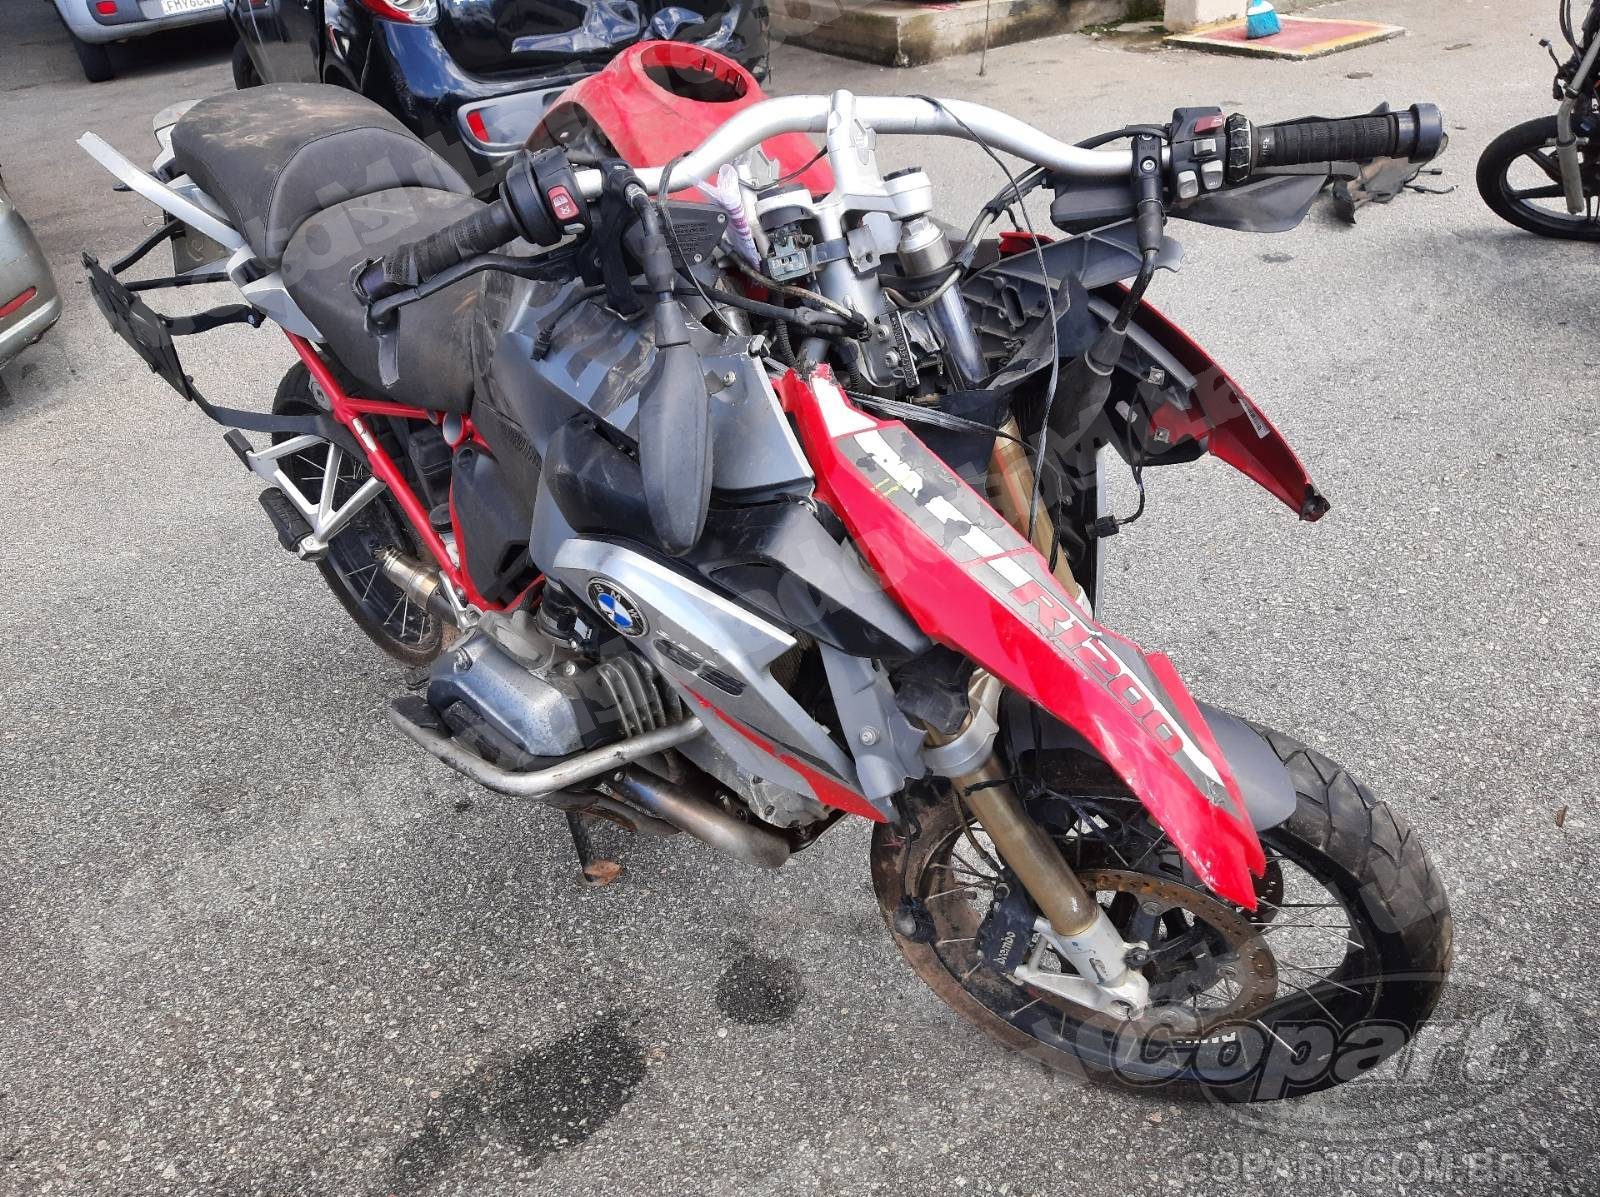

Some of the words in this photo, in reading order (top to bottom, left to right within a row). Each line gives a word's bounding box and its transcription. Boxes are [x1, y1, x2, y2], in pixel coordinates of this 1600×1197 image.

[594, 583, 640, 620] BMW
[1009, 580, 1184, 754] R1200
[992, 931, 1016, 965] brembo
